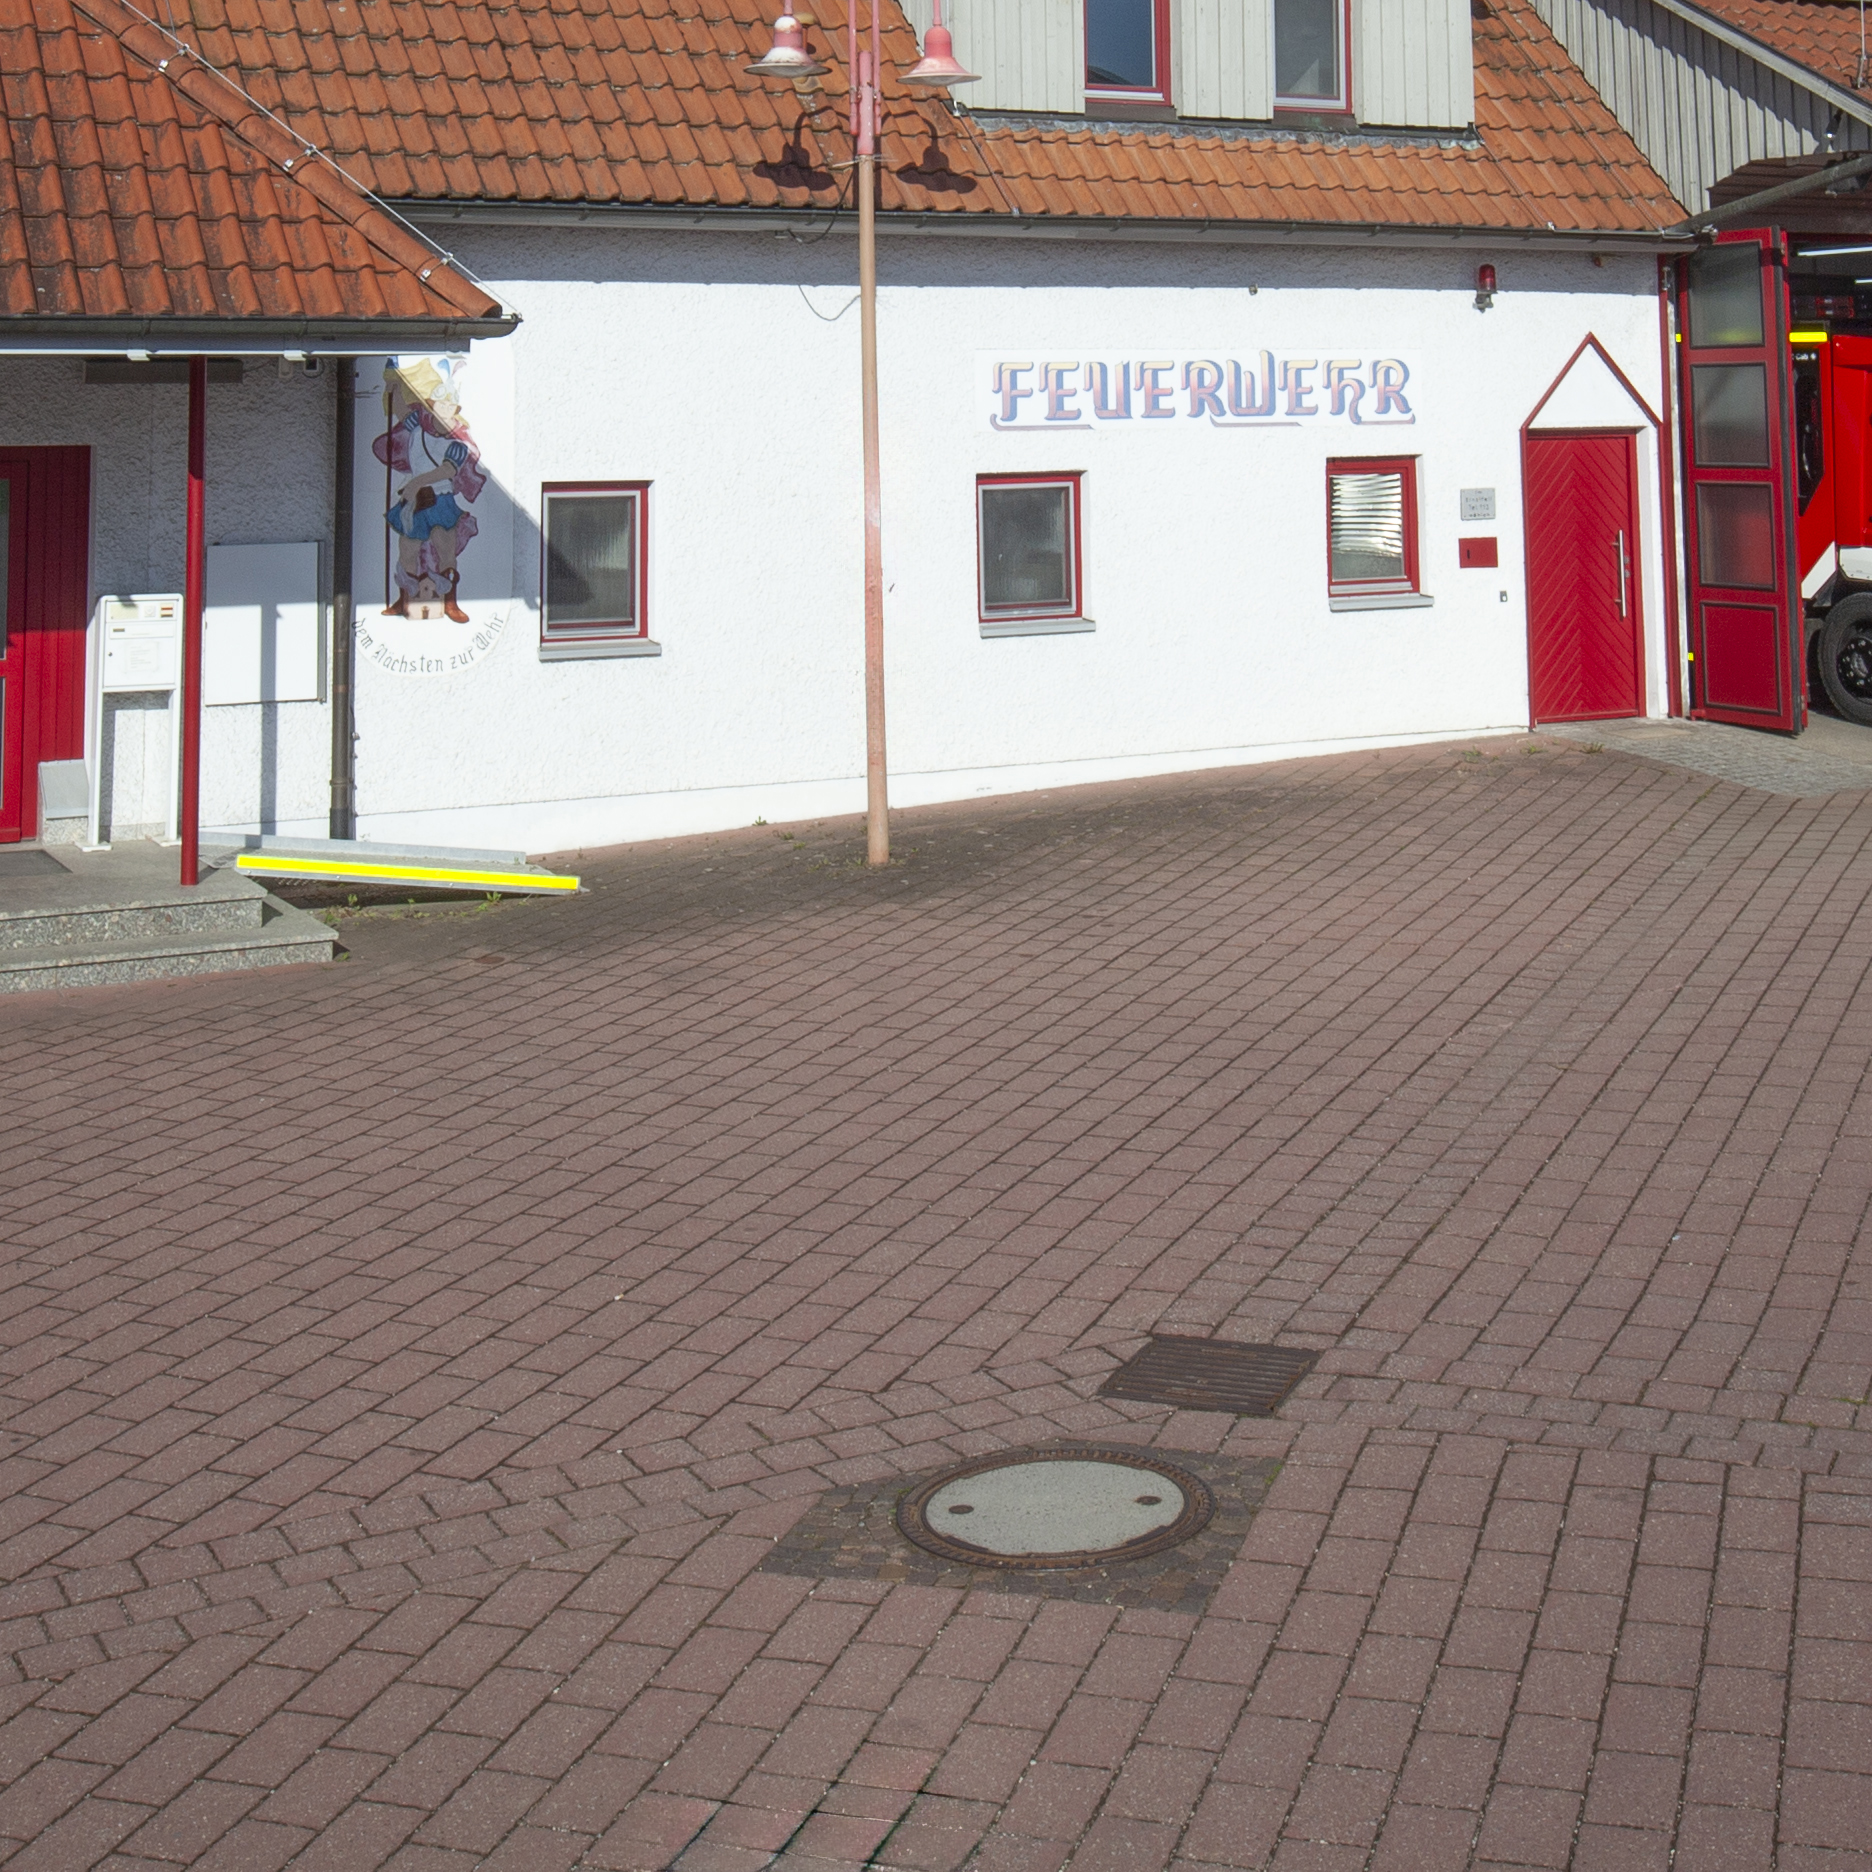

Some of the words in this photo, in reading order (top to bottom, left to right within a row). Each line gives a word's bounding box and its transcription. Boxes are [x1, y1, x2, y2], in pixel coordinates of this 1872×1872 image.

[991, 349, 1416, 430] FEUERWEHR
[372, 643, 444, 673] Nächsten
[450, 645, 474, 669] zur
[472, 612, 504, 651] Wehr
